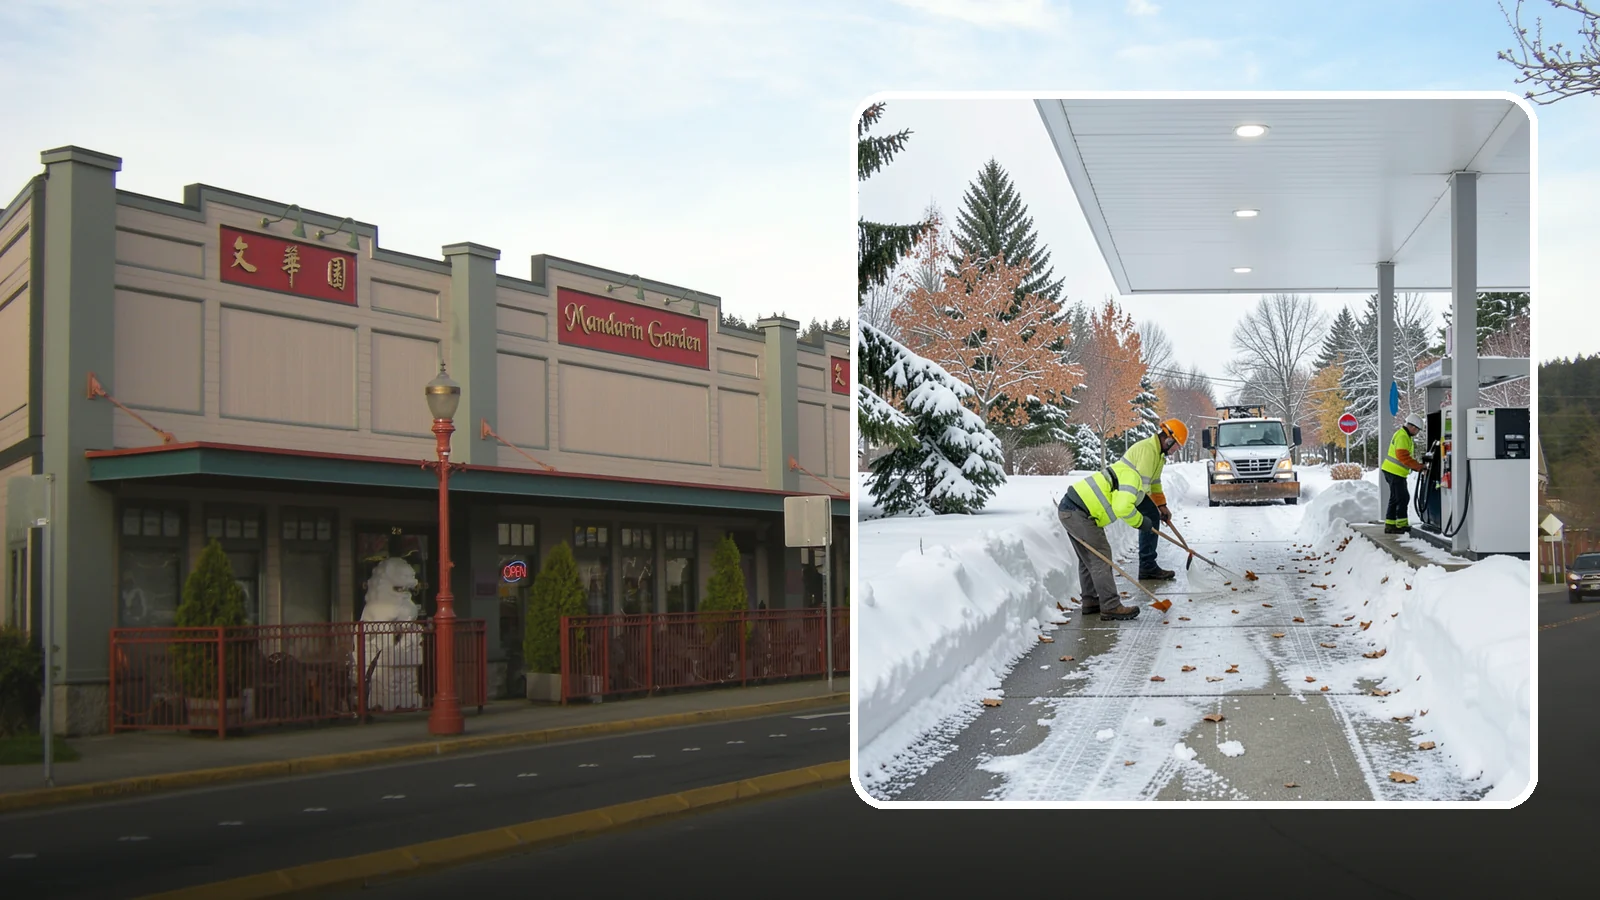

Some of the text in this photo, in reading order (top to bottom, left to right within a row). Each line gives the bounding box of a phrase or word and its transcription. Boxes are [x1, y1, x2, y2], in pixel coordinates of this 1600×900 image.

[564, 302, 701, 352] Mandarin Garden
[503, 565, 527, 578] OPEN
